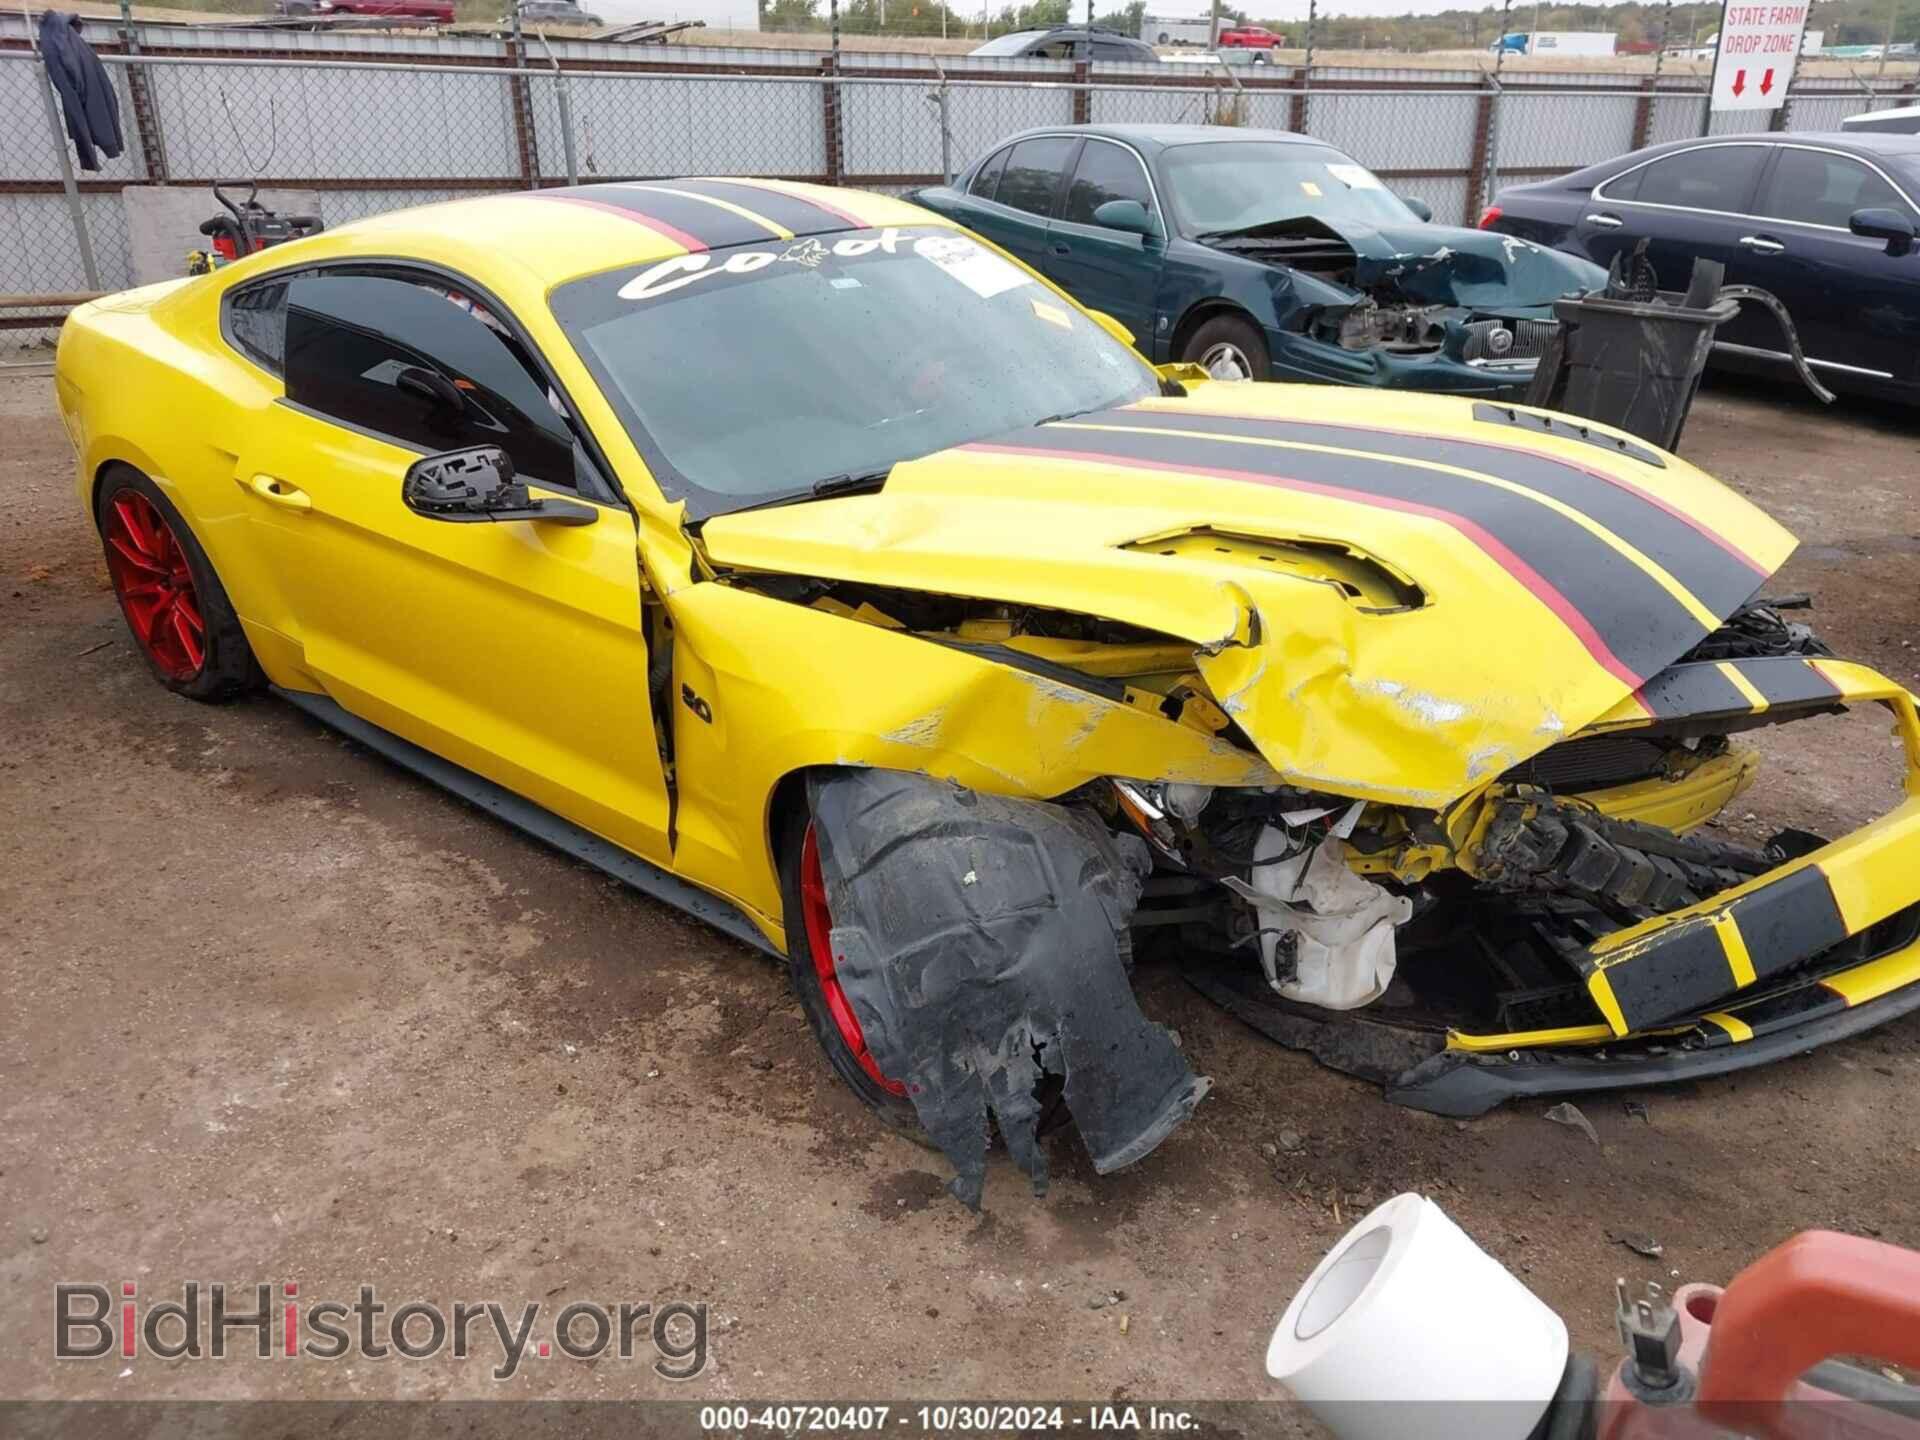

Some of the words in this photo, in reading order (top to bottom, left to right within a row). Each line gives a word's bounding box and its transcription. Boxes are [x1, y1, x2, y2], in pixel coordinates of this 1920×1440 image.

[1728, 7, 1766, 26] STATE
[1769, 6, 1805, 24] FARM
[1726, 35, 1761, 53] DROP
[1762, 34, 1796, 53] ZONE
